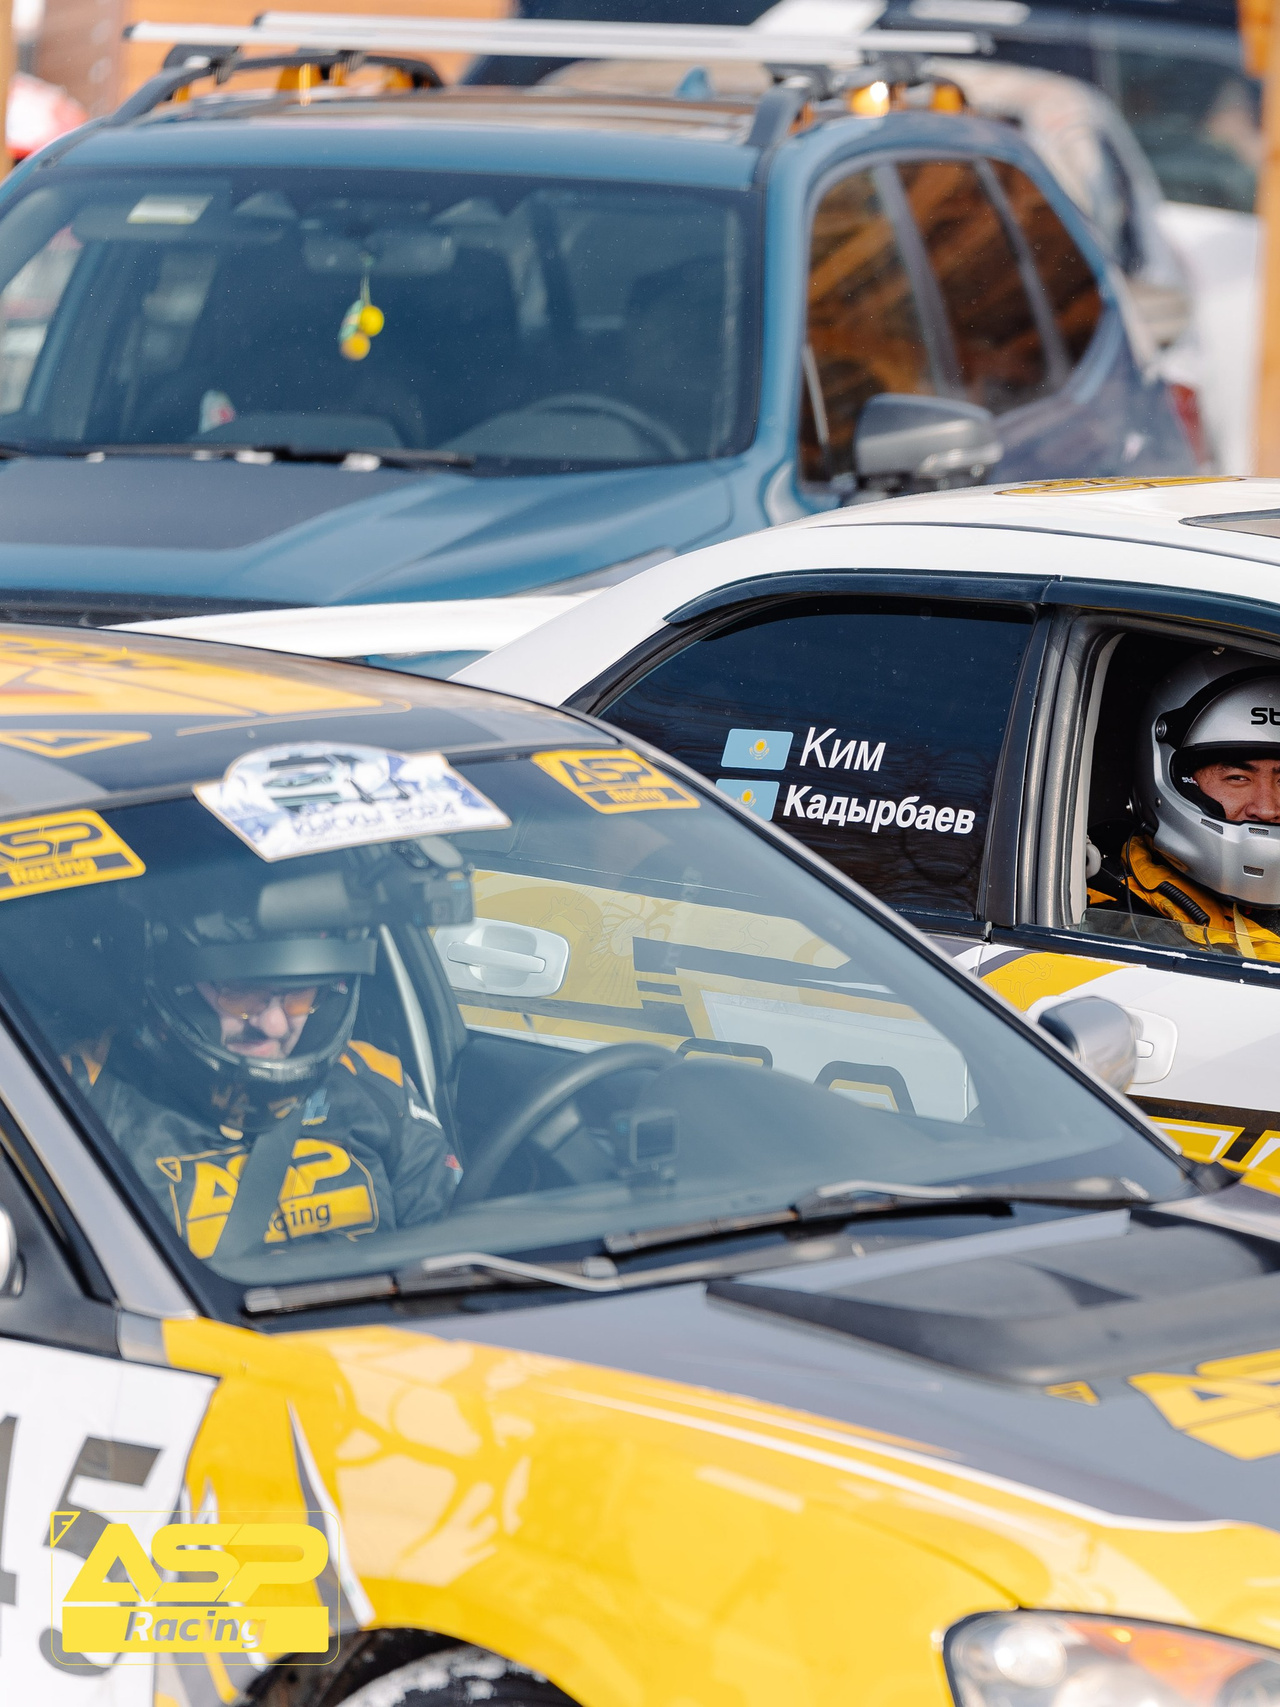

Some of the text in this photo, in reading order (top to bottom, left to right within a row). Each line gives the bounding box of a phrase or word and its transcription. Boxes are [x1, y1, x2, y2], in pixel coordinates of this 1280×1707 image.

[799, 726, 887, 773] Ким
[782, 784, 976, 834] Кадырбаев
[0, 822, 103, 862] SP
